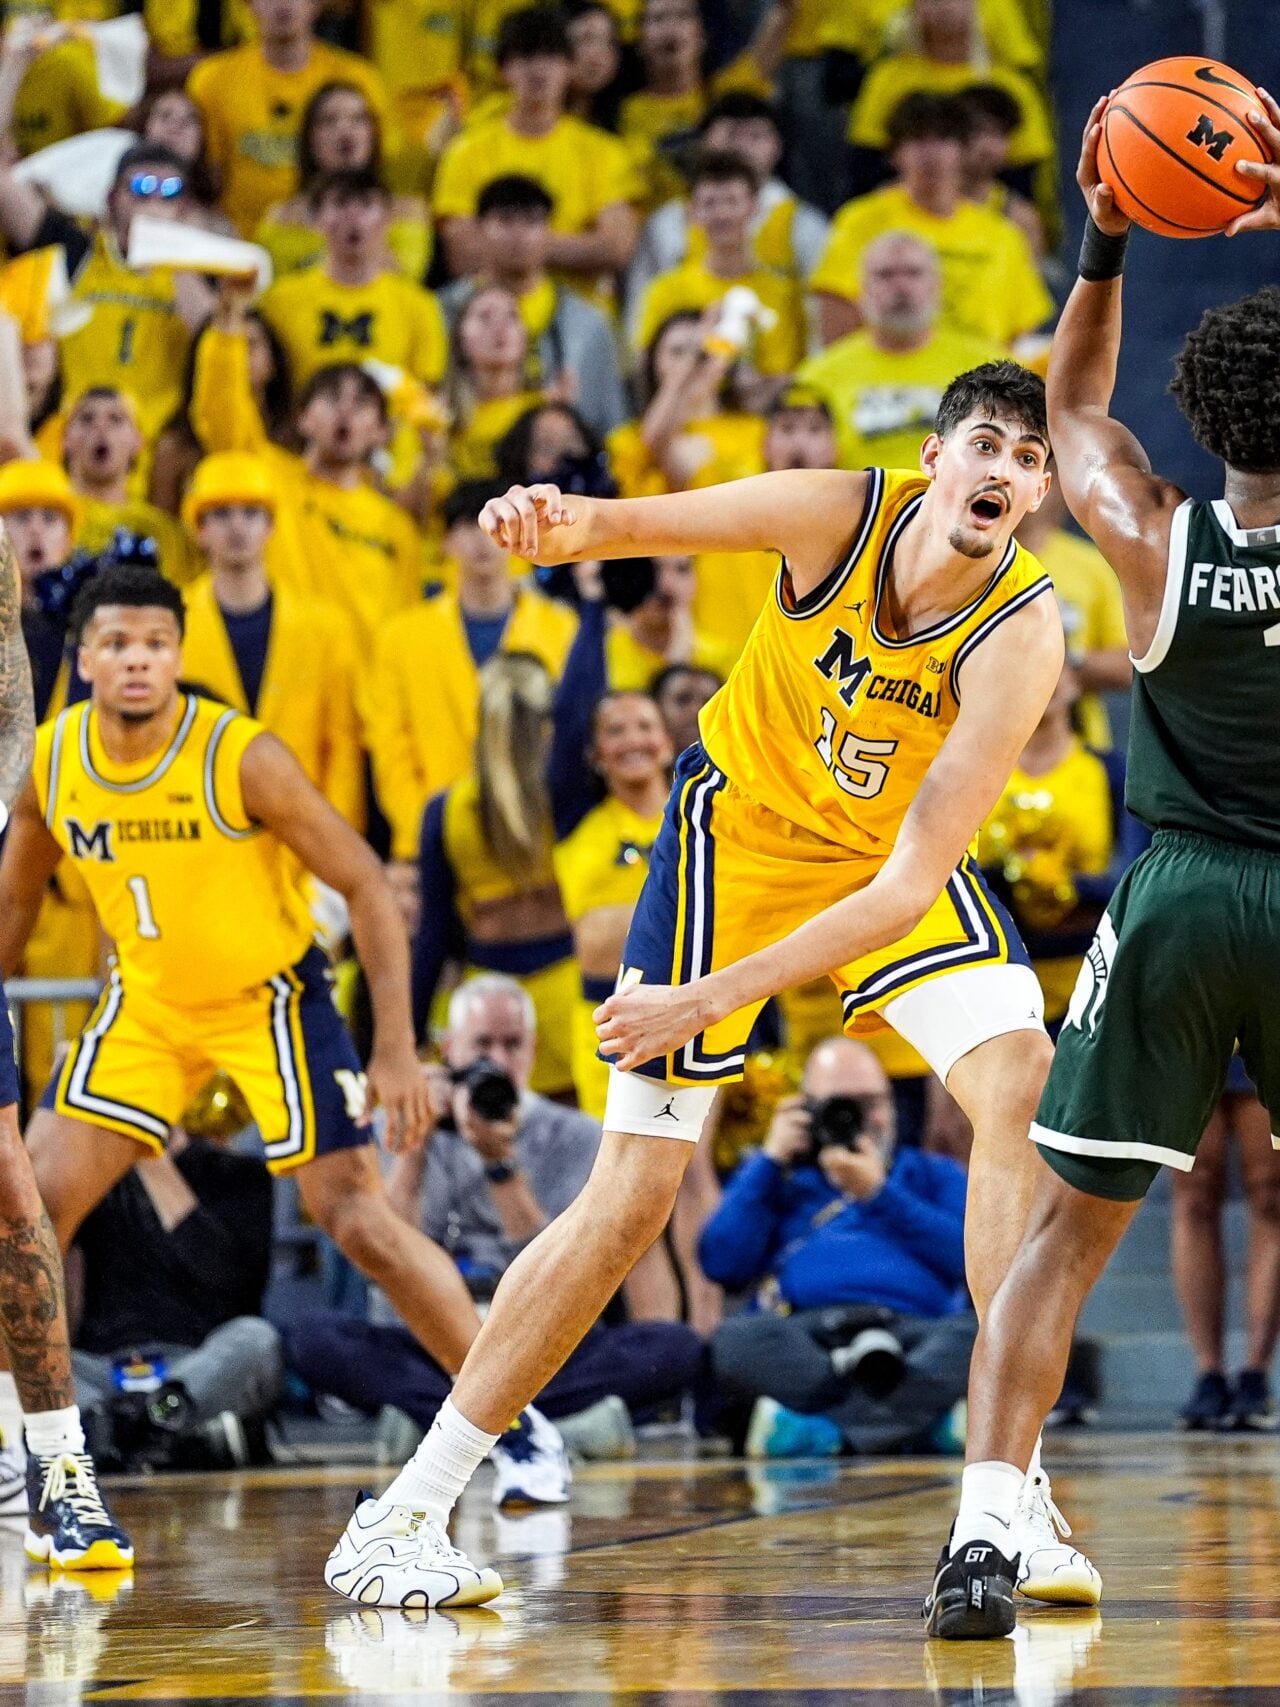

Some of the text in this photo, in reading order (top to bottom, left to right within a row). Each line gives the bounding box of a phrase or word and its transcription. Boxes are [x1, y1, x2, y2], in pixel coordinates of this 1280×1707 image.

[1185, 113, 1236, 162] M
[319, 311, 371, 347] M
[814, 706, 900, 800] 15
[66, 816, 202, 864] MICHIGAN
[125, 873, 161, 941] 1
[965, 1547, 993, 1563] GT
